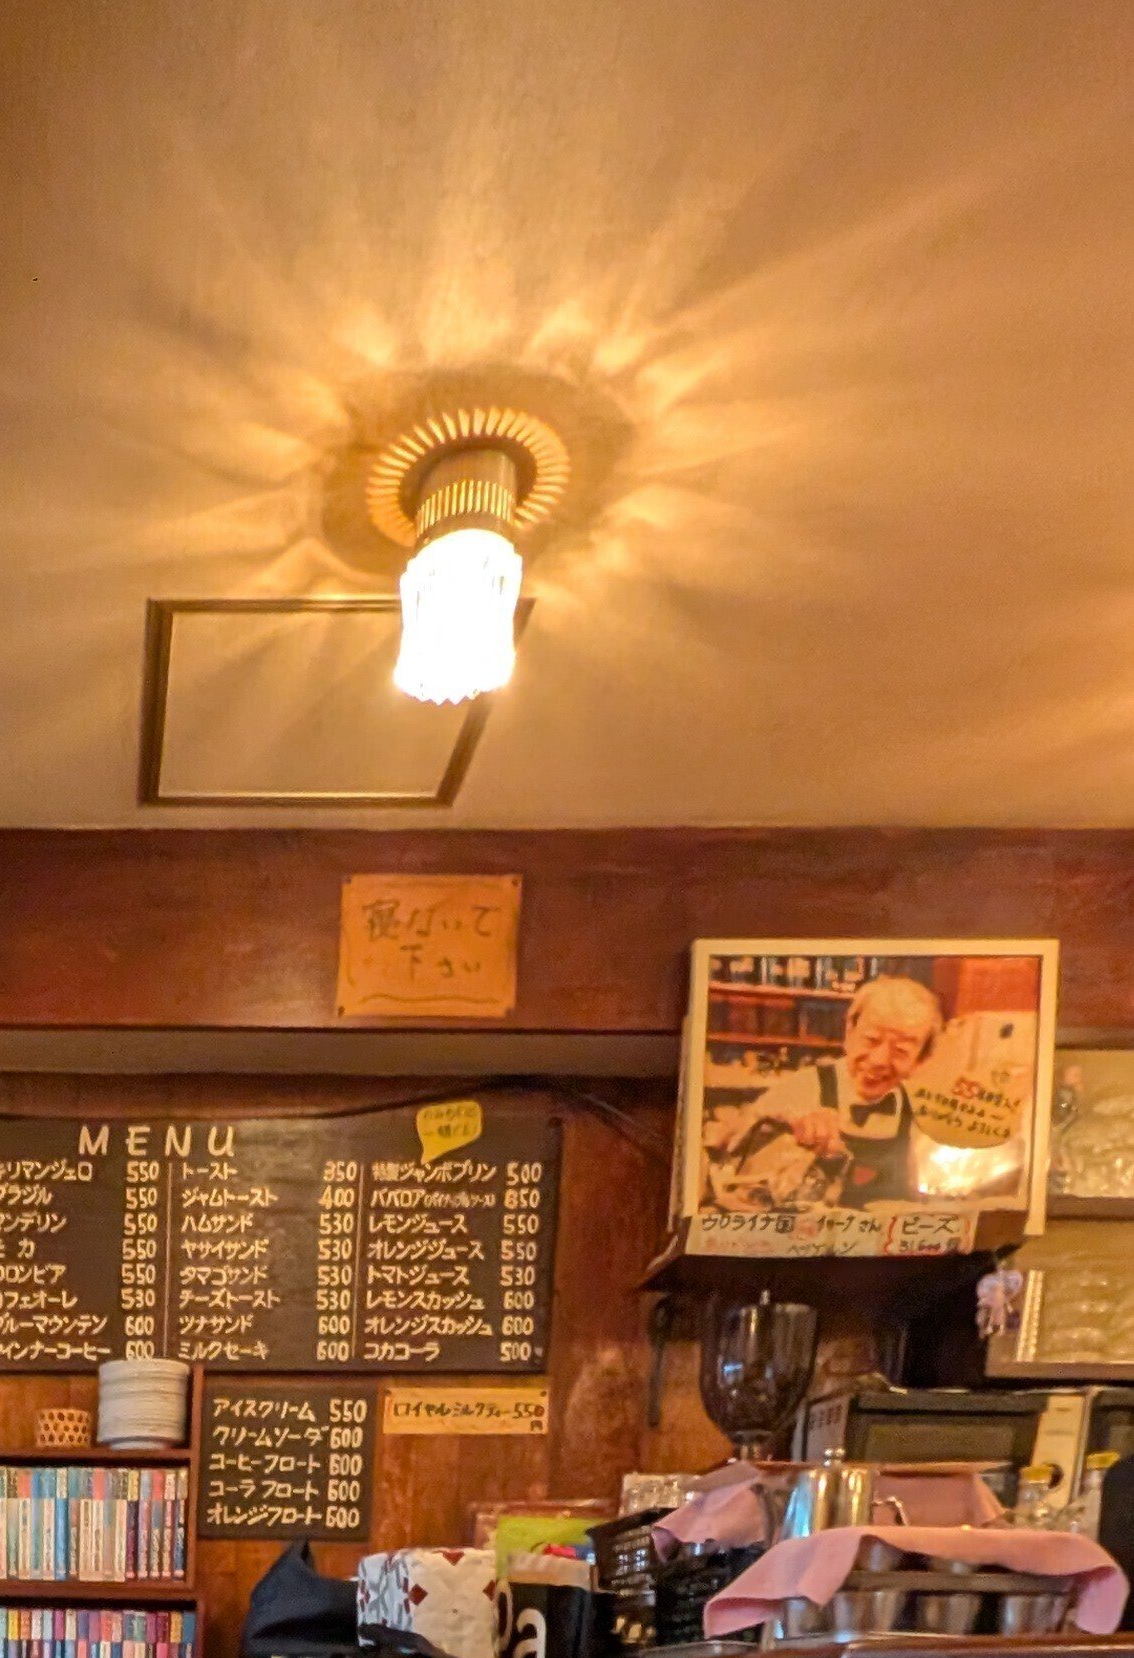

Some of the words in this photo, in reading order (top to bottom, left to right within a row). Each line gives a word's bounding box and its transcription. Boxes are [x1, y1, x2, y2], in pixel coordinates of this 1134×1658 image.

[78, 1124, 235, 1158] MENU
[126, 1160, 160, 1183] 550
[182, 1161, 238, 1181] トースト
[323, 1160, 358, 1182] 350
[506, 1161, 542, 1186] 500
[125, 1186, 158, 1209] 550
[181, 1186, 279, 1208] ジャムトースト
[318, 1185, 355, 1210] 400
[123, 1212, 158, 1236] 550
[181, 1213, 254, 1233] ハムサンド
[319, 1213, 354, 1235] 530
[369, 1213, 468, 1234] レモンジュース
[503, 1213, 540, 1235] 550
[122, 1238, 157, 1261] 550
[181, 1238, 270, 1261] ヤサイサンド
[318, 1238, 353, 1261] 530
[367, 1238, 485, 1260] オレンジジュース
[501, 1239, 537, 1261] 550
[121, 1263, 156, 1286] 550
[179, 1264, 268, 1286] タマゴサンド
[318, 1264, 352, 1286] 530
[368, 1264, 470, 1286] トマトジュース
[500, 1265, 535, 1287] 530
[121, 1288, 156, 1311] 530
[179, 1288, 281, 1310] チーズトースト
[316, 1288, 351, 1311] 530
[366, 1290, 485, 1311] レモンスカッシュ
[503, 1290, 535, 1311] 600
[125, 1315, 155, 1336] 600
[179, 1313, 254, 1335] ツナサンド
[318, 1314, 351, 1336] 600
[364, 1313, 494, 1336] オレンジスカッシュ
[501, 1315, 535, 1336] 600
[125, 1340, 155, 1361] 600
[178, 1340, 269, 1361] ミルクセーキ
[317, 1340, 349, 1362] 600
[363, 1342, 441, 1362] コカコーラ
[499, 1341, 532, 1362] 500
[213, 1399, 316, 1422] アイスクリーム
[329, 1399, 367, 1423] 550
[213, 1425, 329, 1448] クリームソーダ
[330, 1426, 364, 1449] 600
[209, 1453, 321, 1474] コーヒーフロート
[329, 1453, 363, 1476] 600
[327, 1479, 361, 1501] 600
[207, 1502, 322, 1527] オレンジフロート
[325, 1506, 360, 1529] 600
